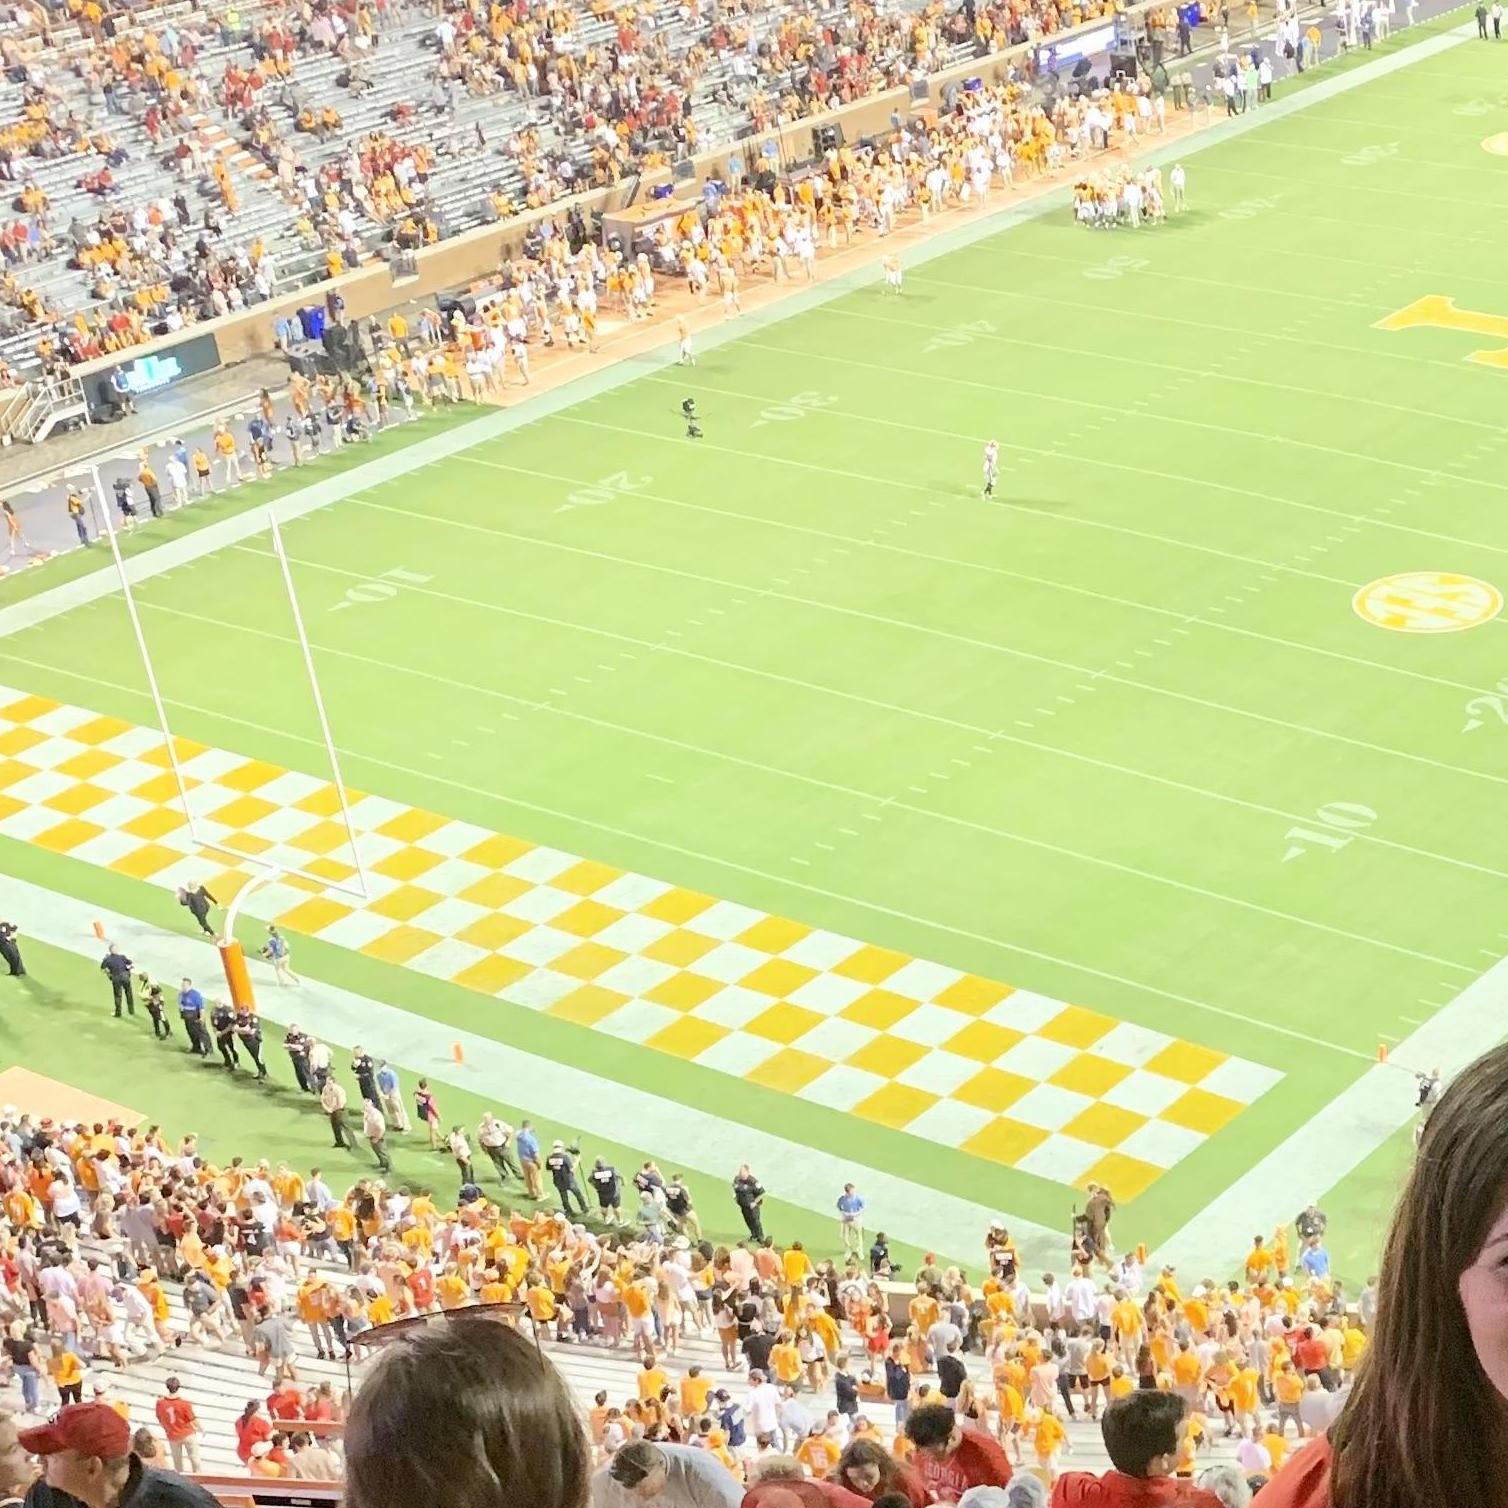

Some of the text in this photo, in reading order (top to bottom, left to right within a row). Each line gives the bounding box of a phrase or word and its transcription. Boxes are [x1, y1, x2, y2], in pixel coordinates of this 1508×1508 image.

[567, 470, 653, 505] 20
[345, 566, 435, 602] 10
[1283, 801, 1378, 854] 10
